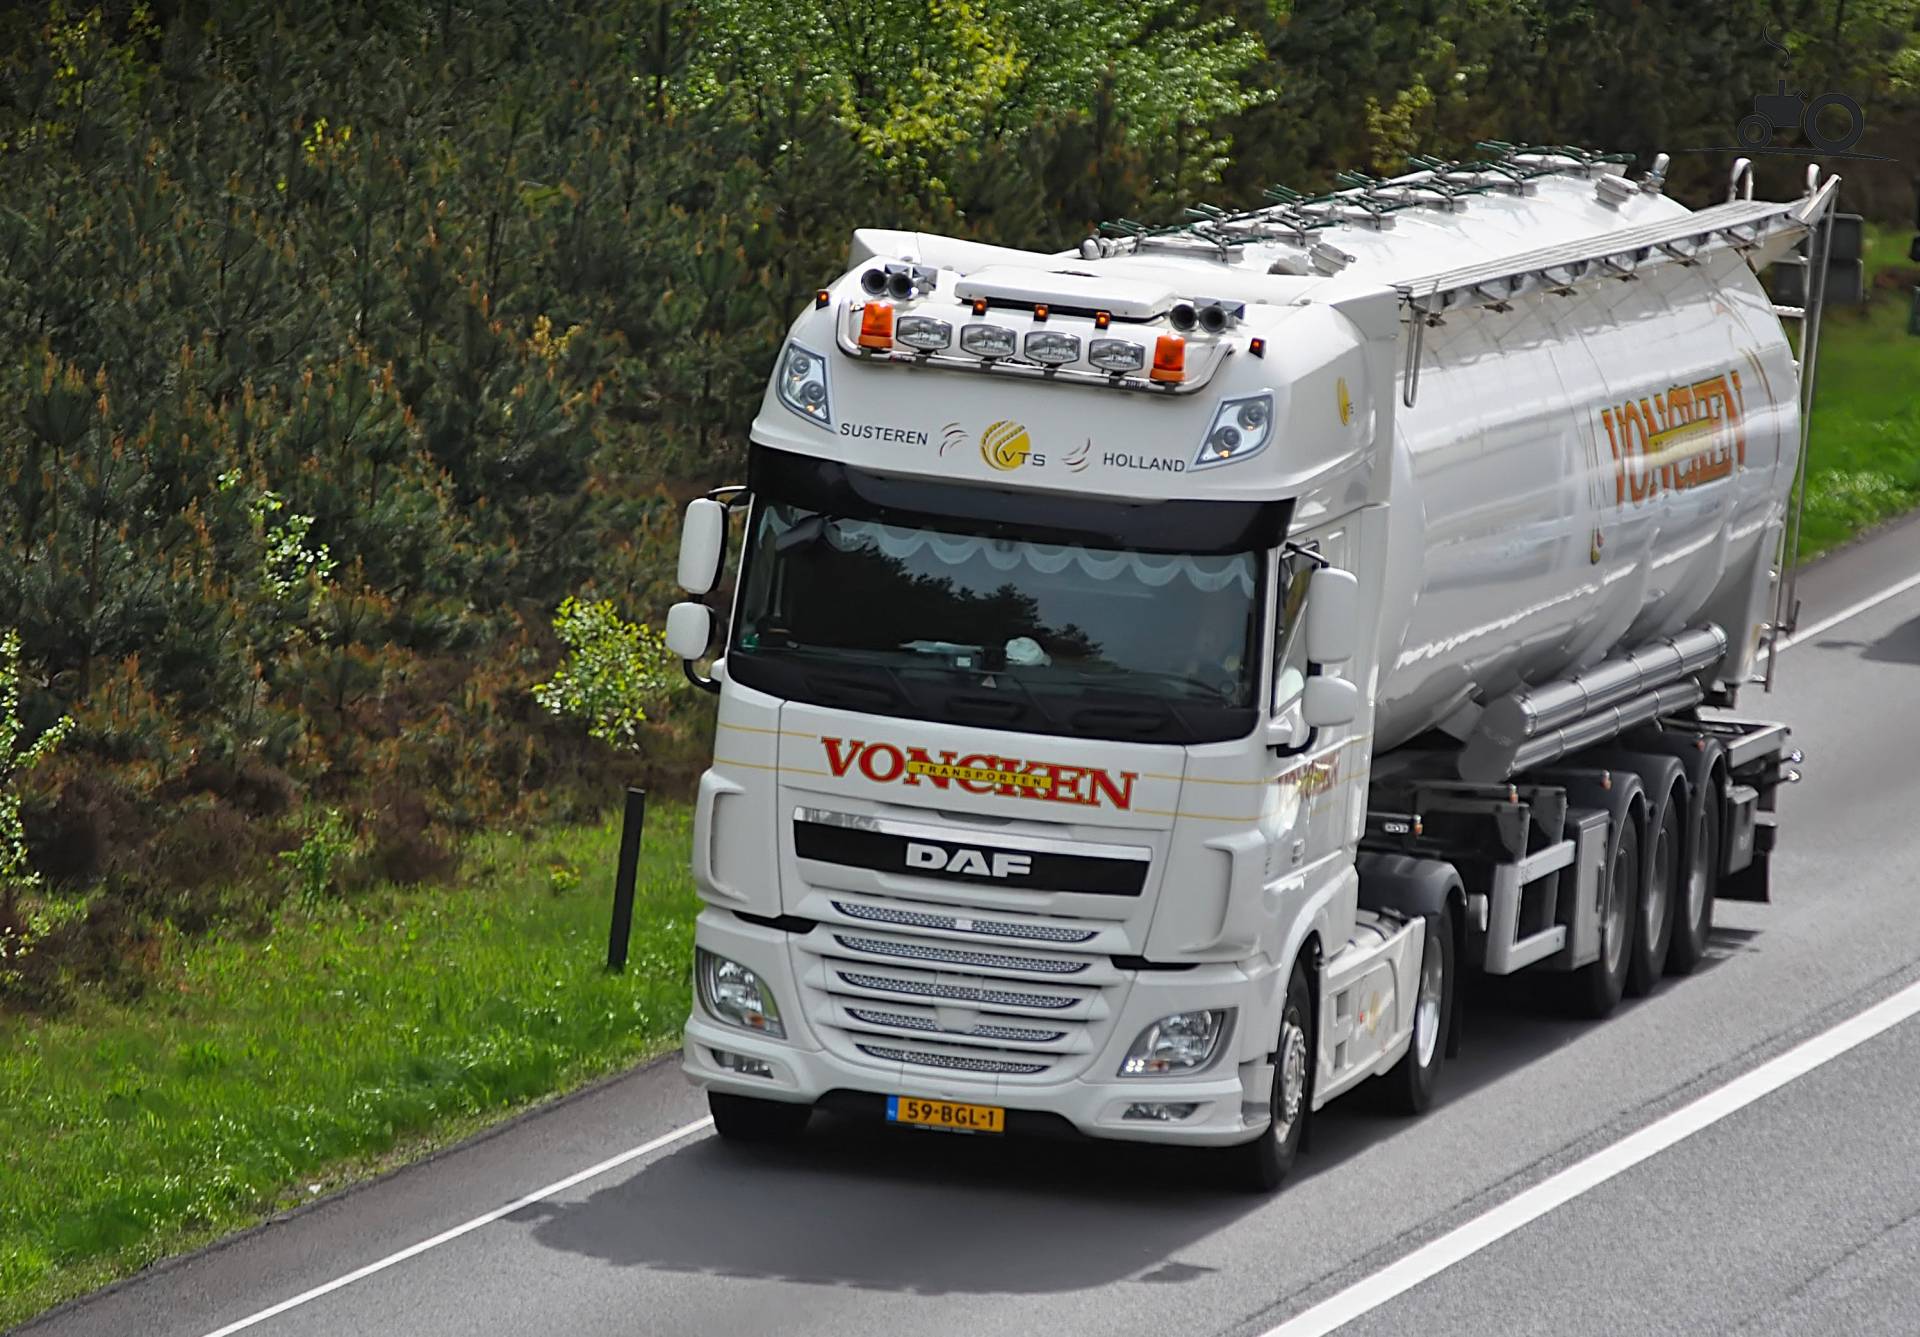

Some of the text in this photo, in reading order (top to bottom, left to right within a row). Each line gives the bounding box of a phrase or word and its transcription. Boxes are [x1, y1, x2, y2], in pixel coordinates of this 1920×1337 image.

[840, 422, 929, 446] SUSTEREN
[1001, 449, 1046, 467] VTS
[1103, 452, 1187, 473] HOLLAND
[821, 736, 1139, 810] VONCKEN
[918, 764, 1043, 787] TRANSPORTEN
[905, 842, 1032, 878] DAF
[907, 1101, 994, 1127] 59-BGL-1
